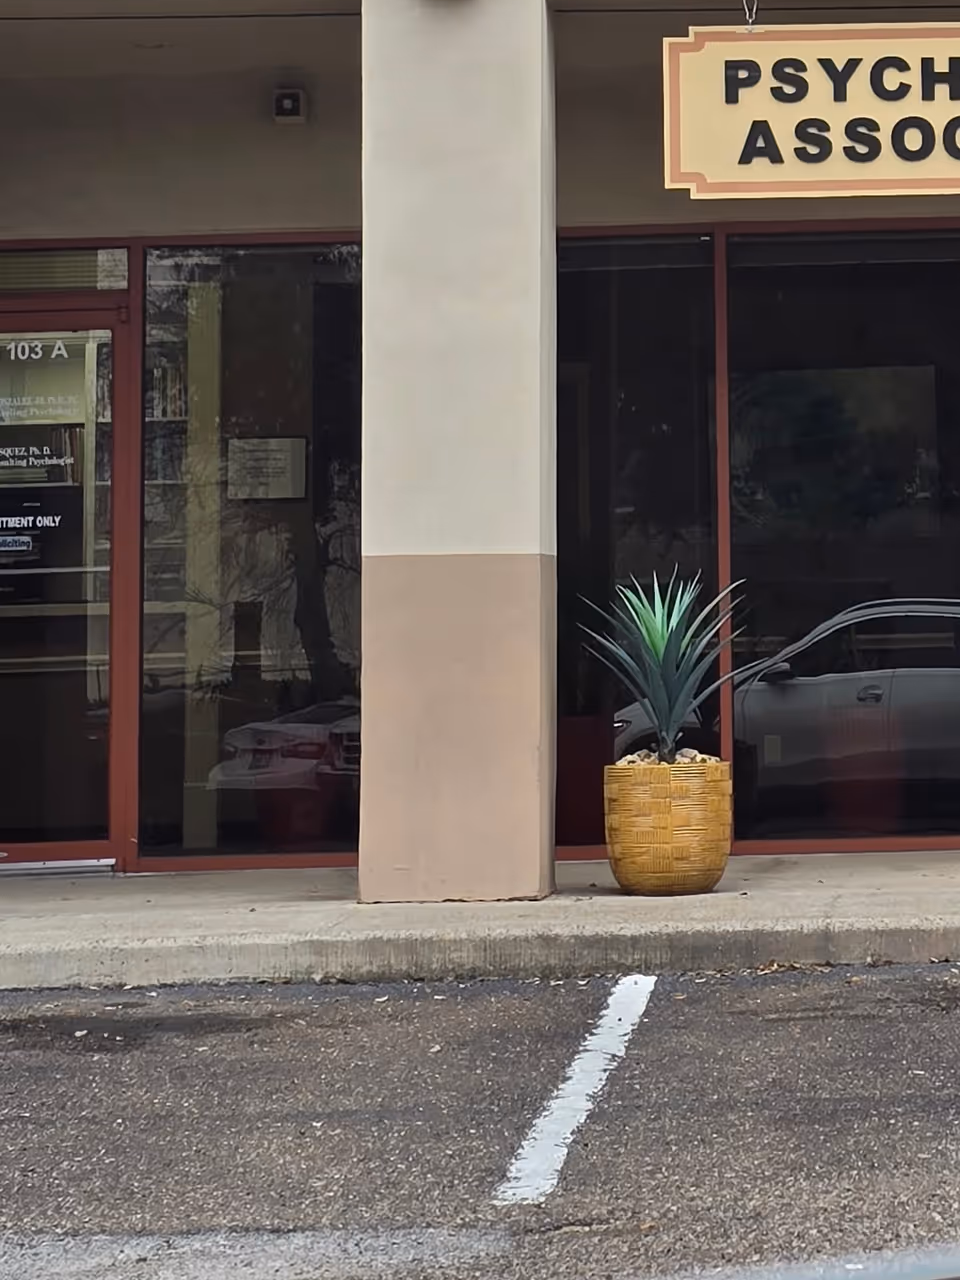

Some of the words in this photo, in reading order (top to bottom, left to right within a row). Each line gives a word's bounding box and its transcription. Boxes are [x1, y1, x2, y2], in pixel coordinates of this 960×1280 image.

[6, 340, 43, 360] 103
[50, 340, 69, 359] A
[36, 514, 62, 528] ONLY
